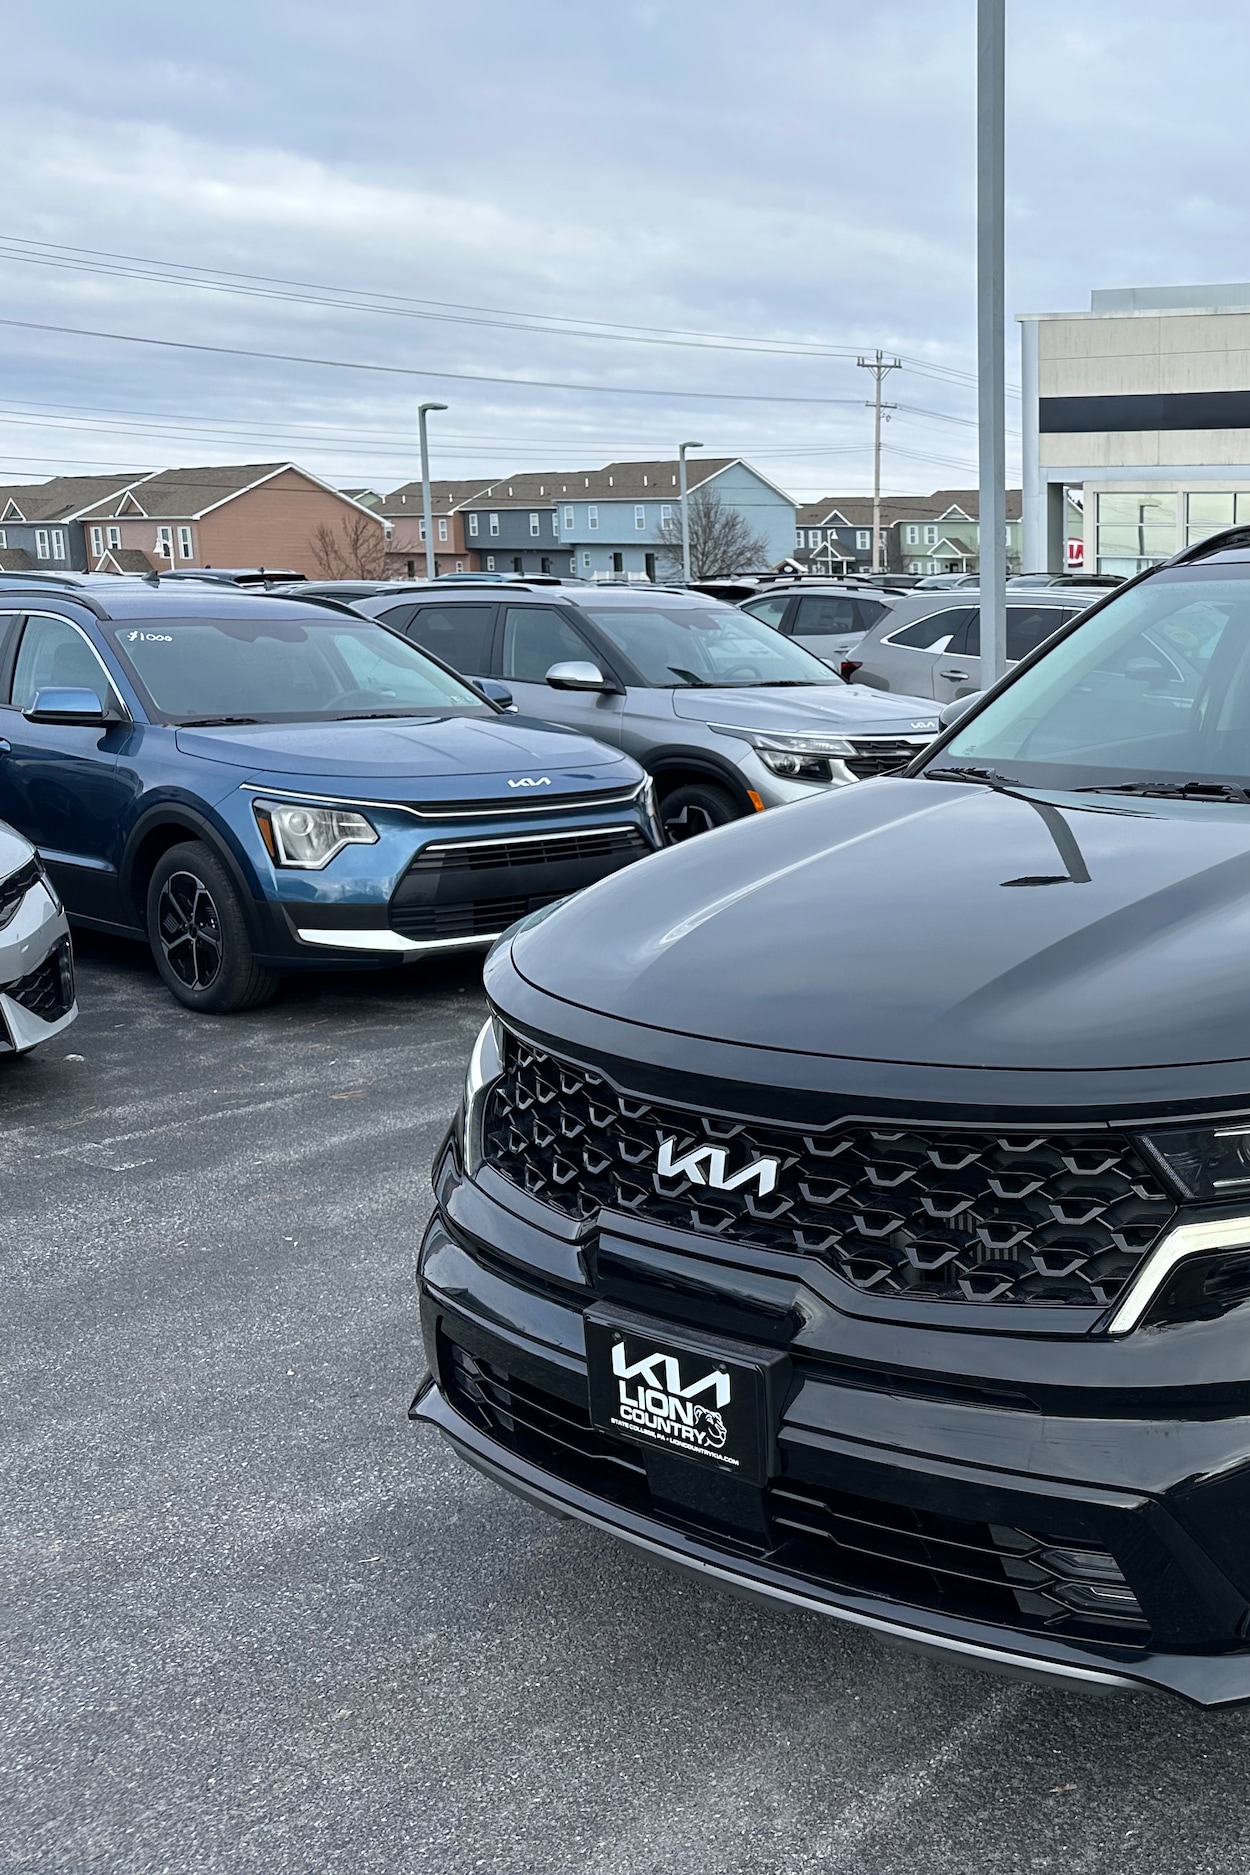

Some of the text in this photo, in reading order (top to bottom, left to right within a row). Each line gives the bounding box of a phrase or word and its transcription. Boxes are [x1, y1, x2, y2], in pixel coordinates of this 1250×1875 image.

[1069, 544, 1083, 559] IA
[127, 630, 173, 642] $1000
[507, 776, 552, 788] KIA
[657, 1139, 778, 1197] KIA
[611, 1341, 731, 1409] KIA
[619, 1379, 694, 1427] LION
[610, 1417, 630, 1429] STATE
[656, 1433, 666, 1441] PA
[620, 1404, 707, 1445] COUNTRY
